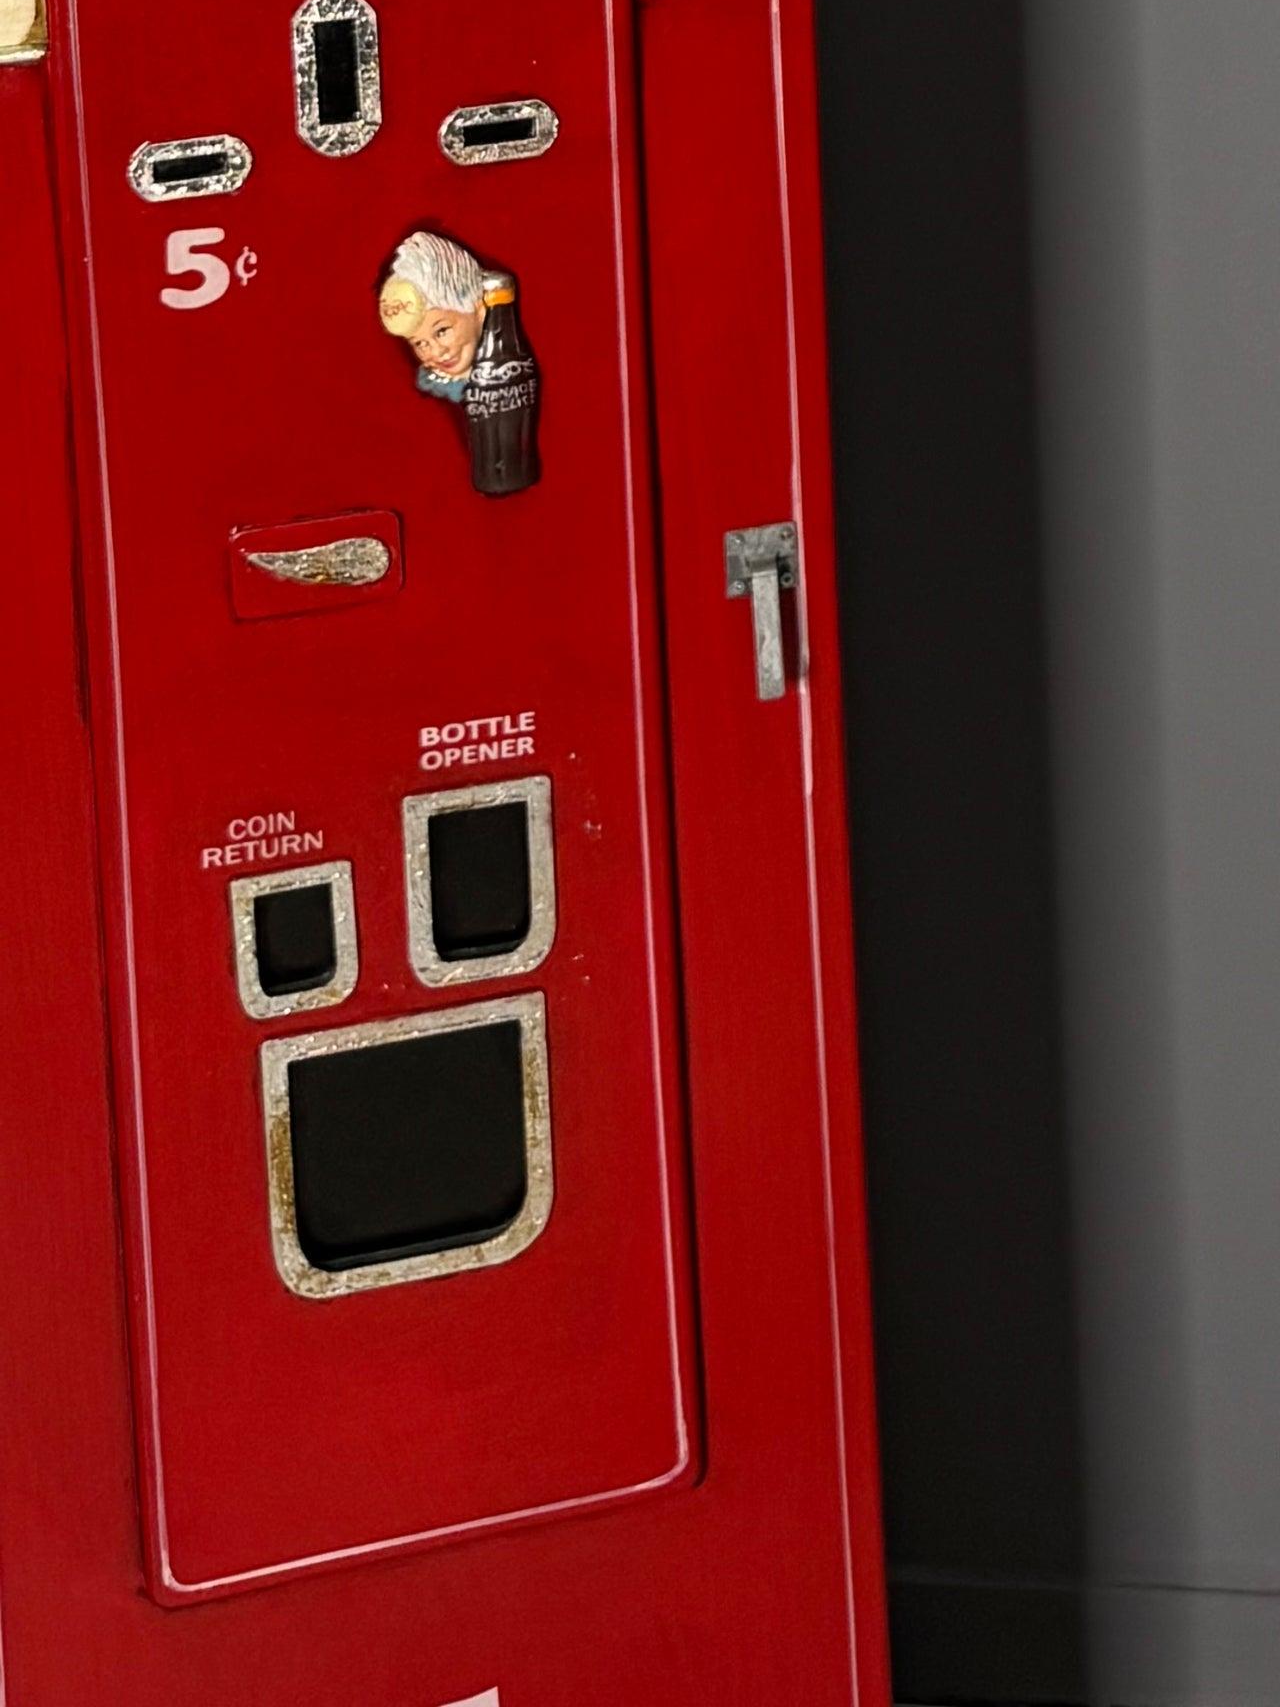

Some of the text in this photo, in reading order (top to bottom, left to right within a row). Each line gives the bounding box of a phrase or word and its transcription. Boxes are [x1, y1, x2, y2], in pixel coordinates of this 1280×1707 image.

[419, 711, 536, 748] BOTTLE
[420, 736, 536, 772] OPENER
[227, 810, 296, 841] COIN
[202, 830, 324, 869] RETURN
